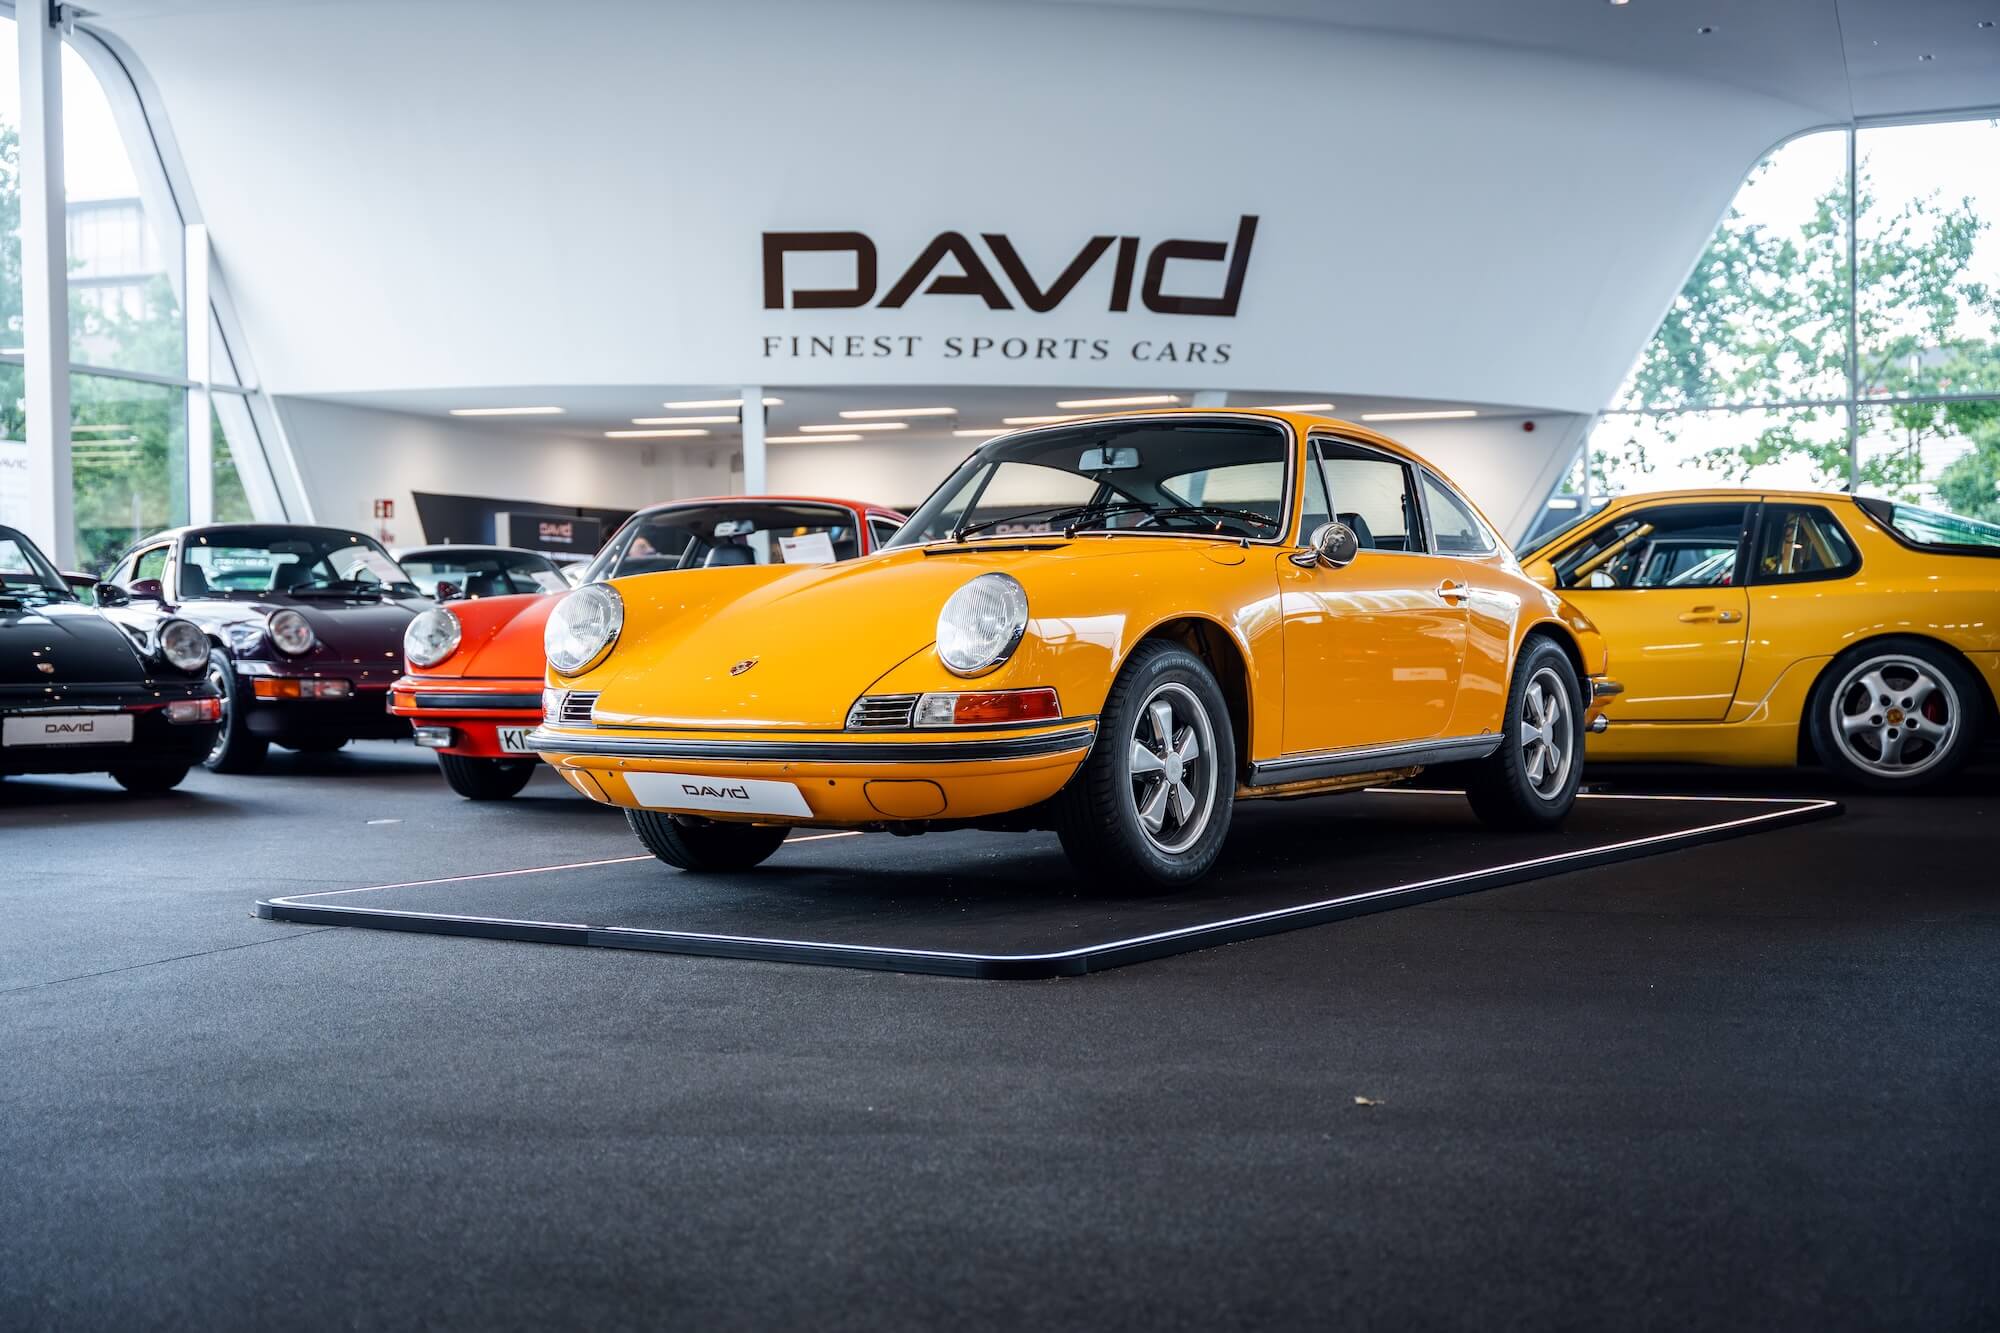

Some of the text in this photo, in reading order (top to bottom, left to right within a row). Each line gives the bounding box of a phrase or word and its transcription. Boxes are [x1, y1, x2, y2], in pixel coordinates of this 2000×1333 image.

[763, 335, 1233, 364] FINEST SPORTS CARS
